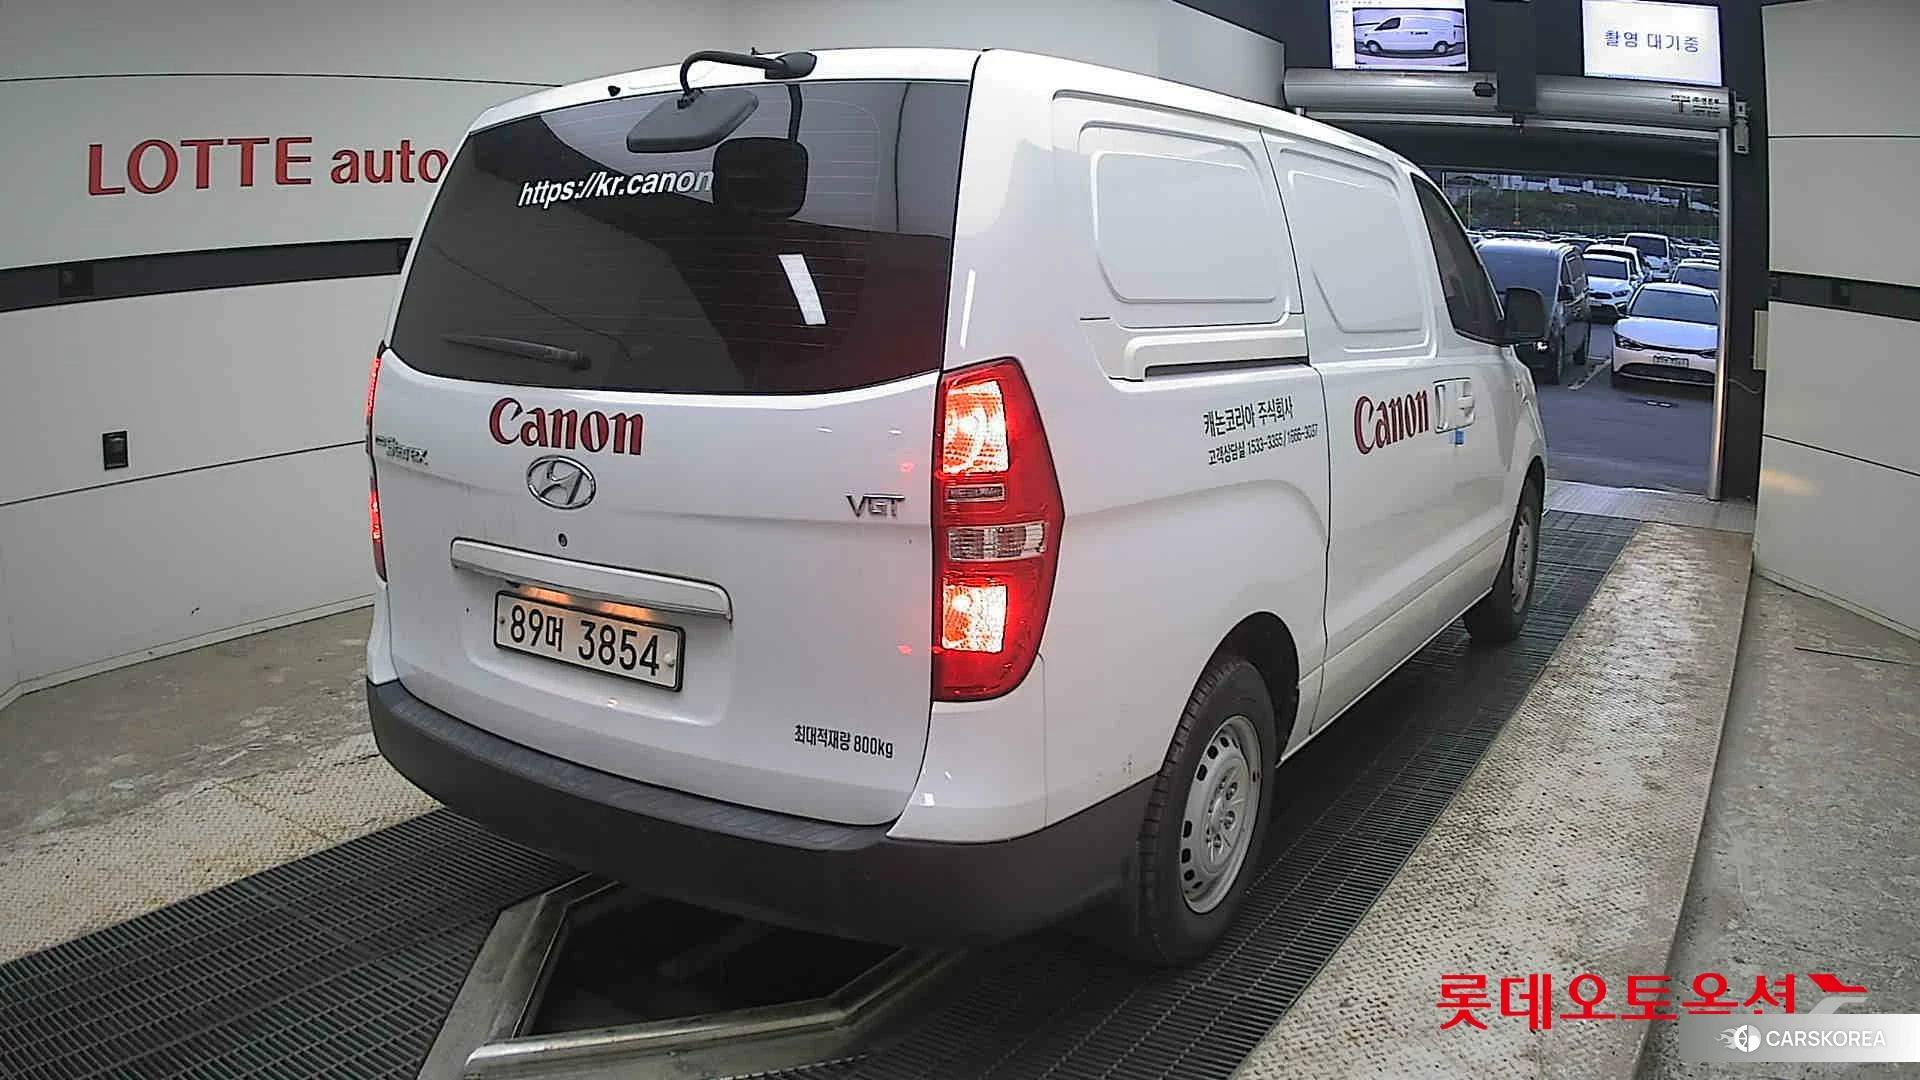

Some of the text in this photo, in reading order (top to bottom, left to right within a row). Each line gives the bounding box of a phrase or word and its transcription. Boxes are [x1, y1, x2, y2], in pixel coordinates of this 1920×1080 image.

[1647, 33, 1699, 53] 대기중
[88, 136, 449, 195] LOTTE auto
[518, 171, 714, 209] https://kr.canon
[489, 397, 644, 456] Canon
[1203, 395, 1294, 437] 캐논코리아 주식회사
[1354, 390, 1429, 454] Canon
[845, 493, 906, 518] VGT
[510, 604, 660, 677] 89머 3854
[794, 724, 893, 759] 최대적재량 800kg
